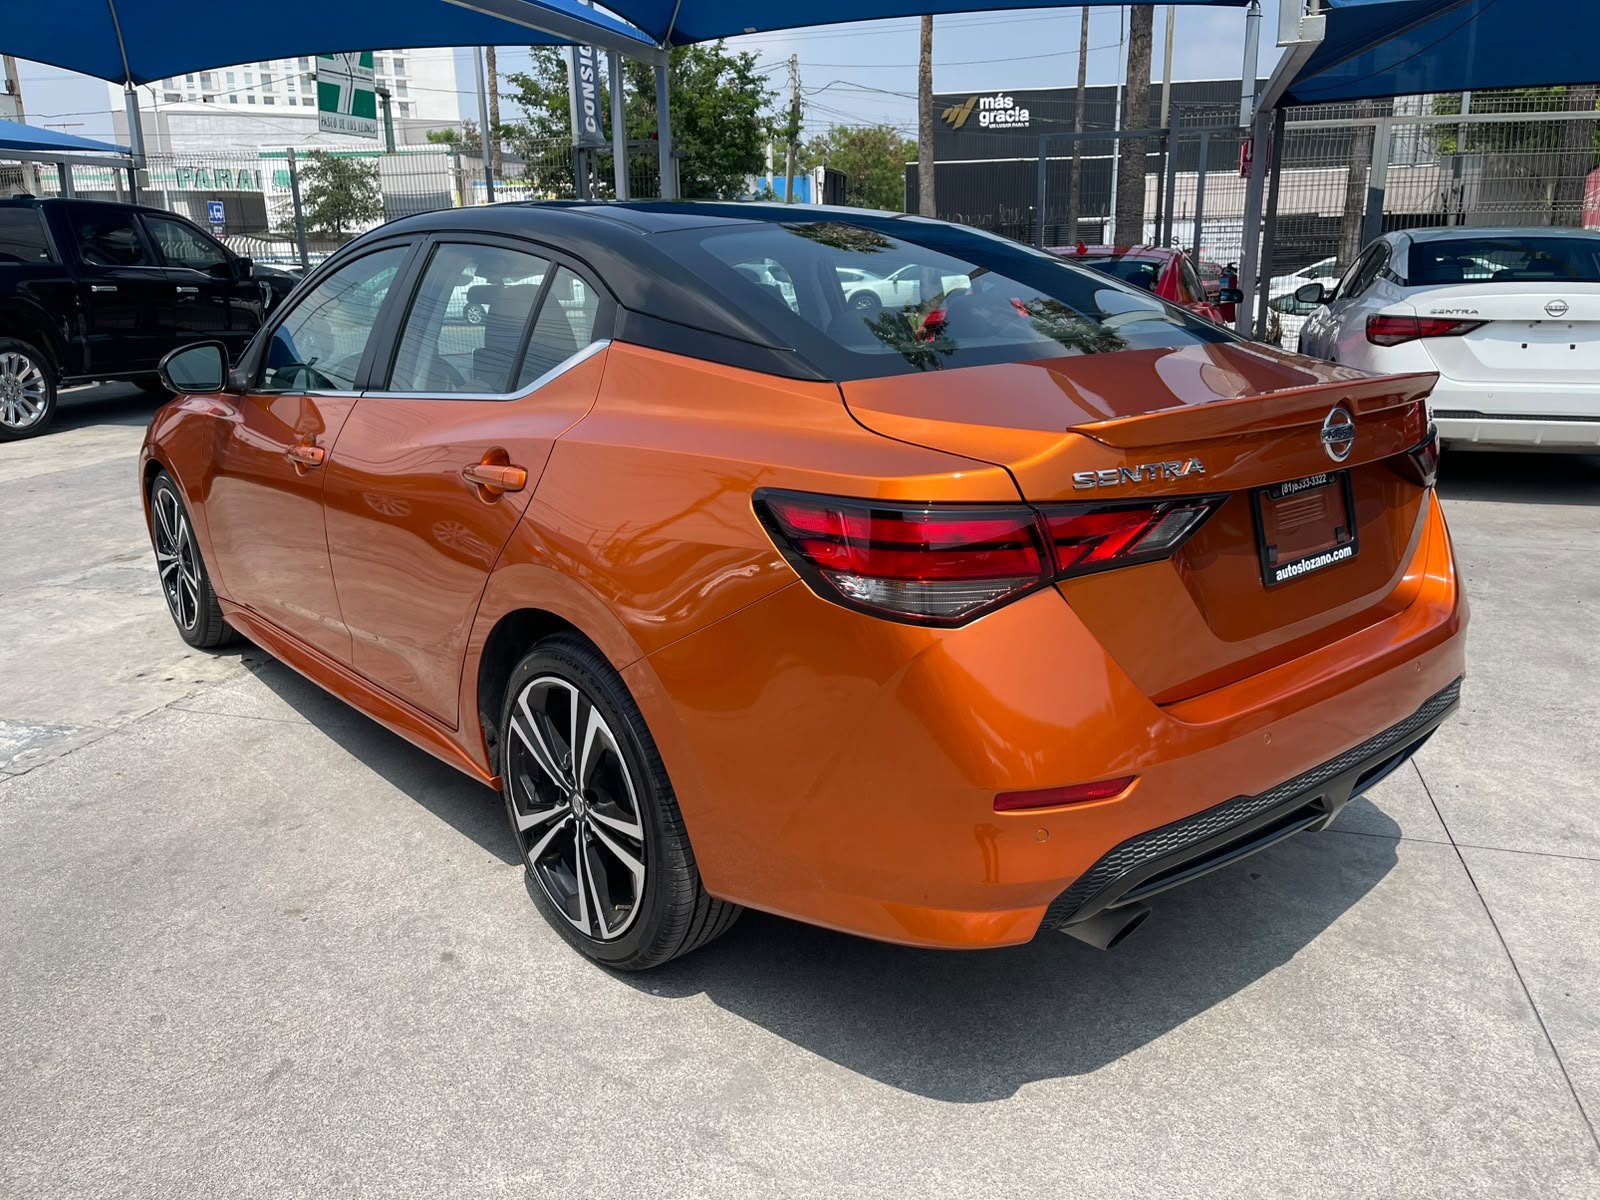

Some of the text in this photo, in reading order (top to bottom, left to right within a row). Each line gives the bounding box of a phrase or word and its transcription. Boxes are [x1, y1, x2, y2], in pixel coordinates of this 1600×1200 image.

[979, 92, 1014, 110] más
[979, 106, 1030, 127] gracia
[1072, 457, 1206, 490] SENTRA
[1276, 546, 1352, 581] autoslozano.com
